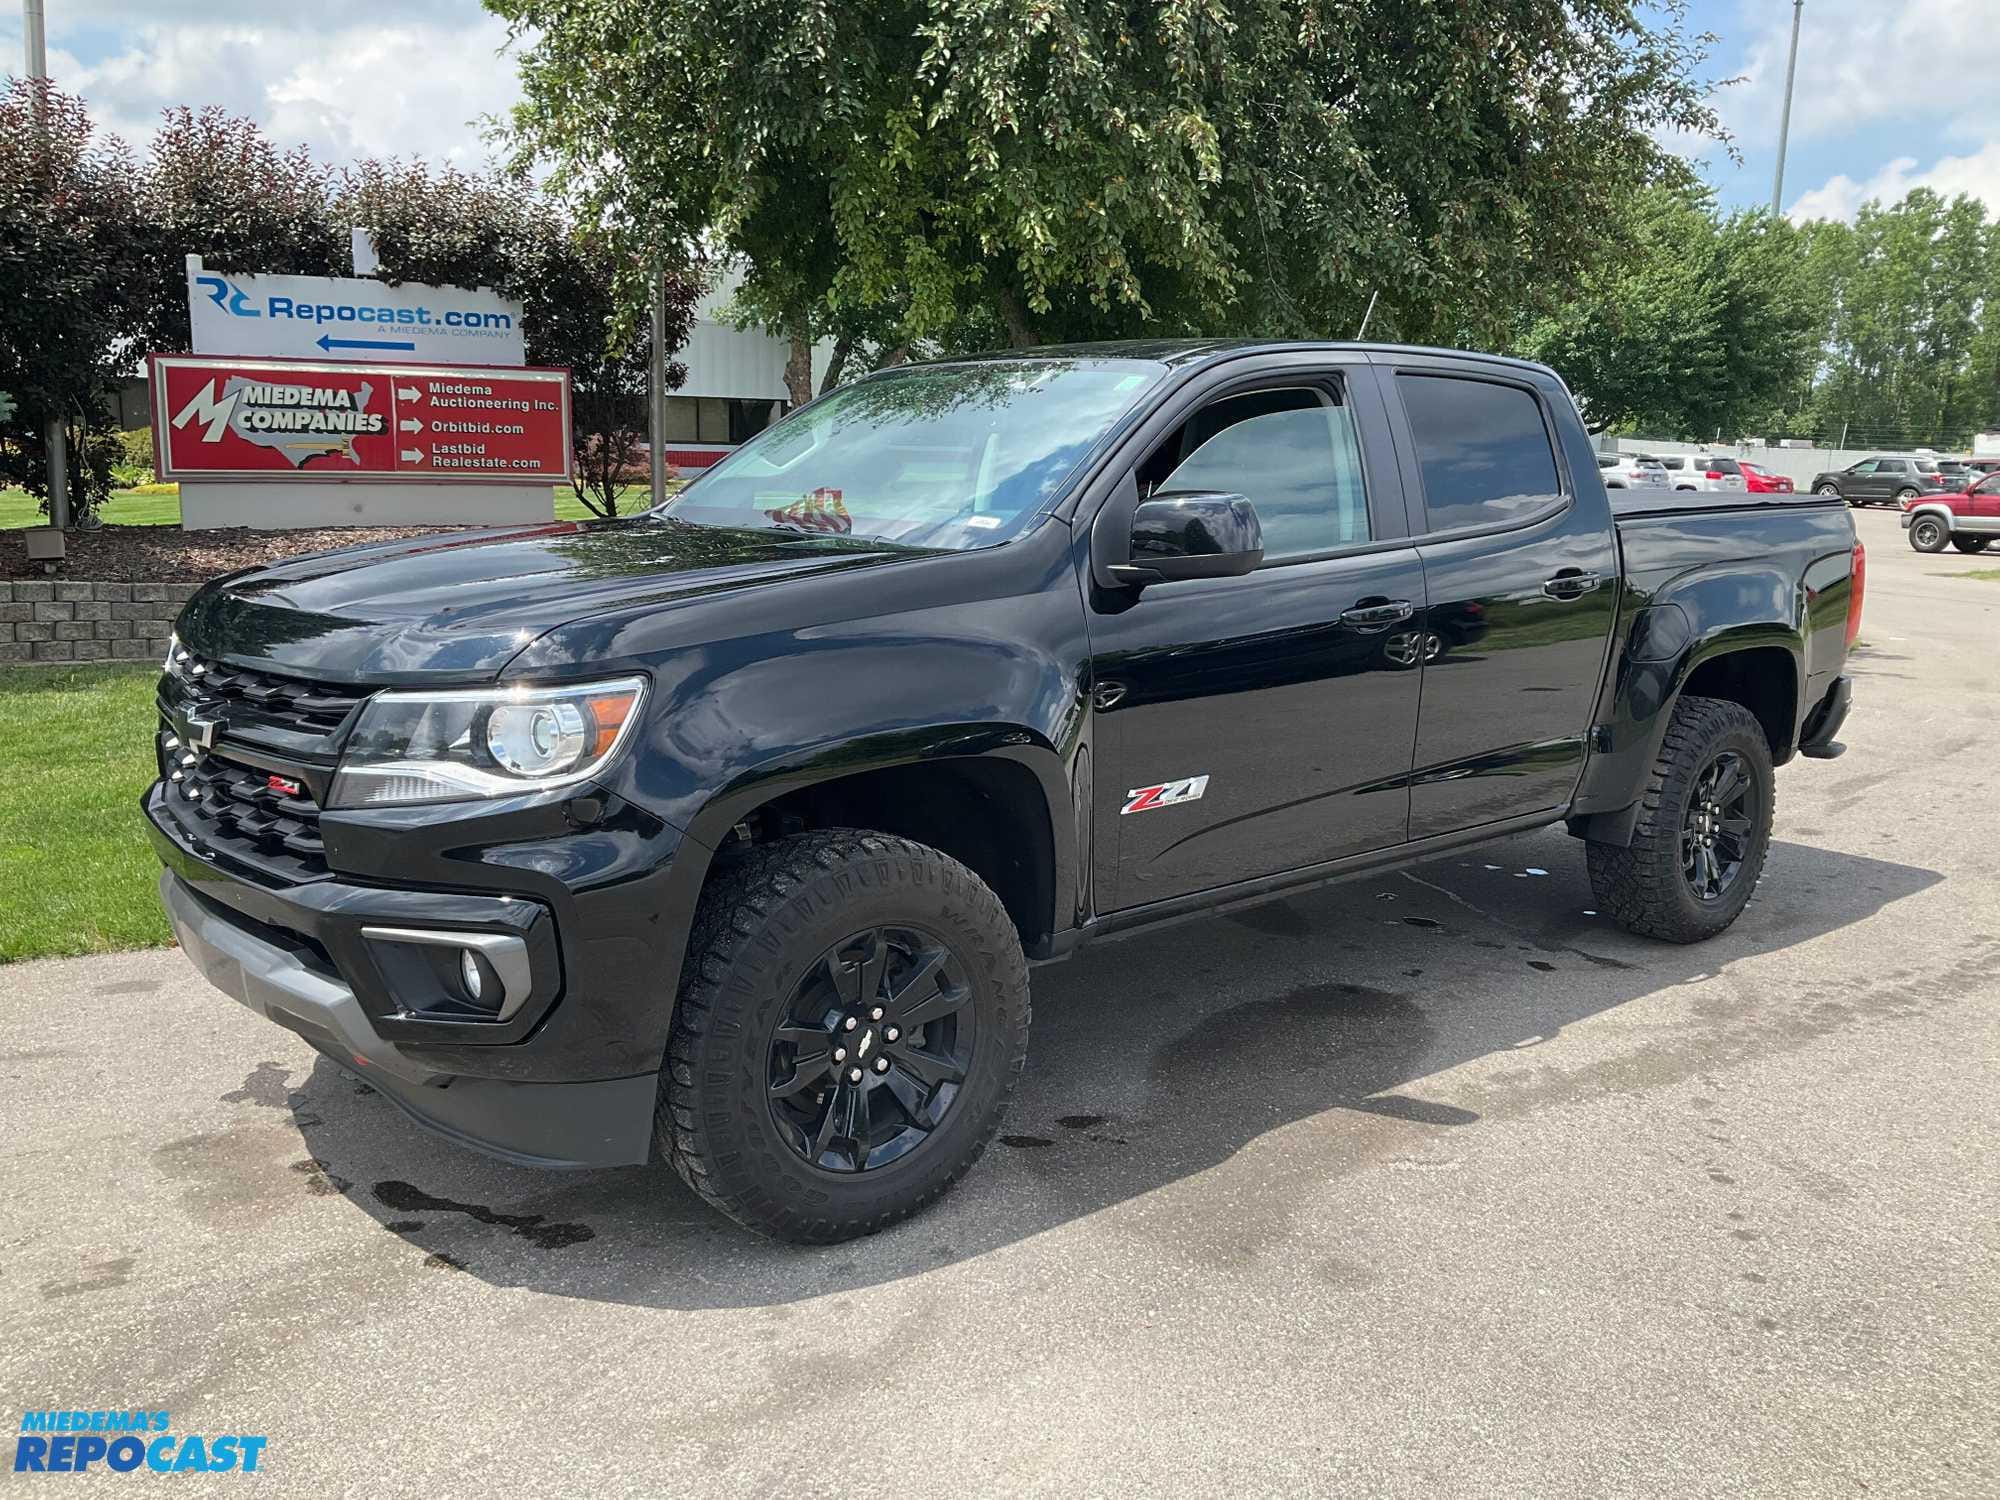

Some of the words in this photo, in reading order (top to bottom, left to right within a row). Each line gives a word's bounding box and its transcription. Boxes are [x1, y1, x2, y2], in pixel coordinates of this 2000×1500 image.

[268, 297, 511, 329] Repocast.com
[377, 325, 386, 333] A
[390, 326, 448, 336] MIEDEMA
[451, 328, 511, 339] COMPANY
[241, 385, 351, 407] MIEDEMA
[429, 382, 493, 395] Miedema
[430, 396, 530, 412] Auctioneering
[534, 399, 559, 411] Inc.
[237, 411, 383, 432] COMPANIES
[431, 420, 524, 434] Orbitbid.com
[432, 442, 486, 455] Lastbid
[432, 455, 541, 469] Realestate.com
[1120, 775, 1210, 814] Z71
